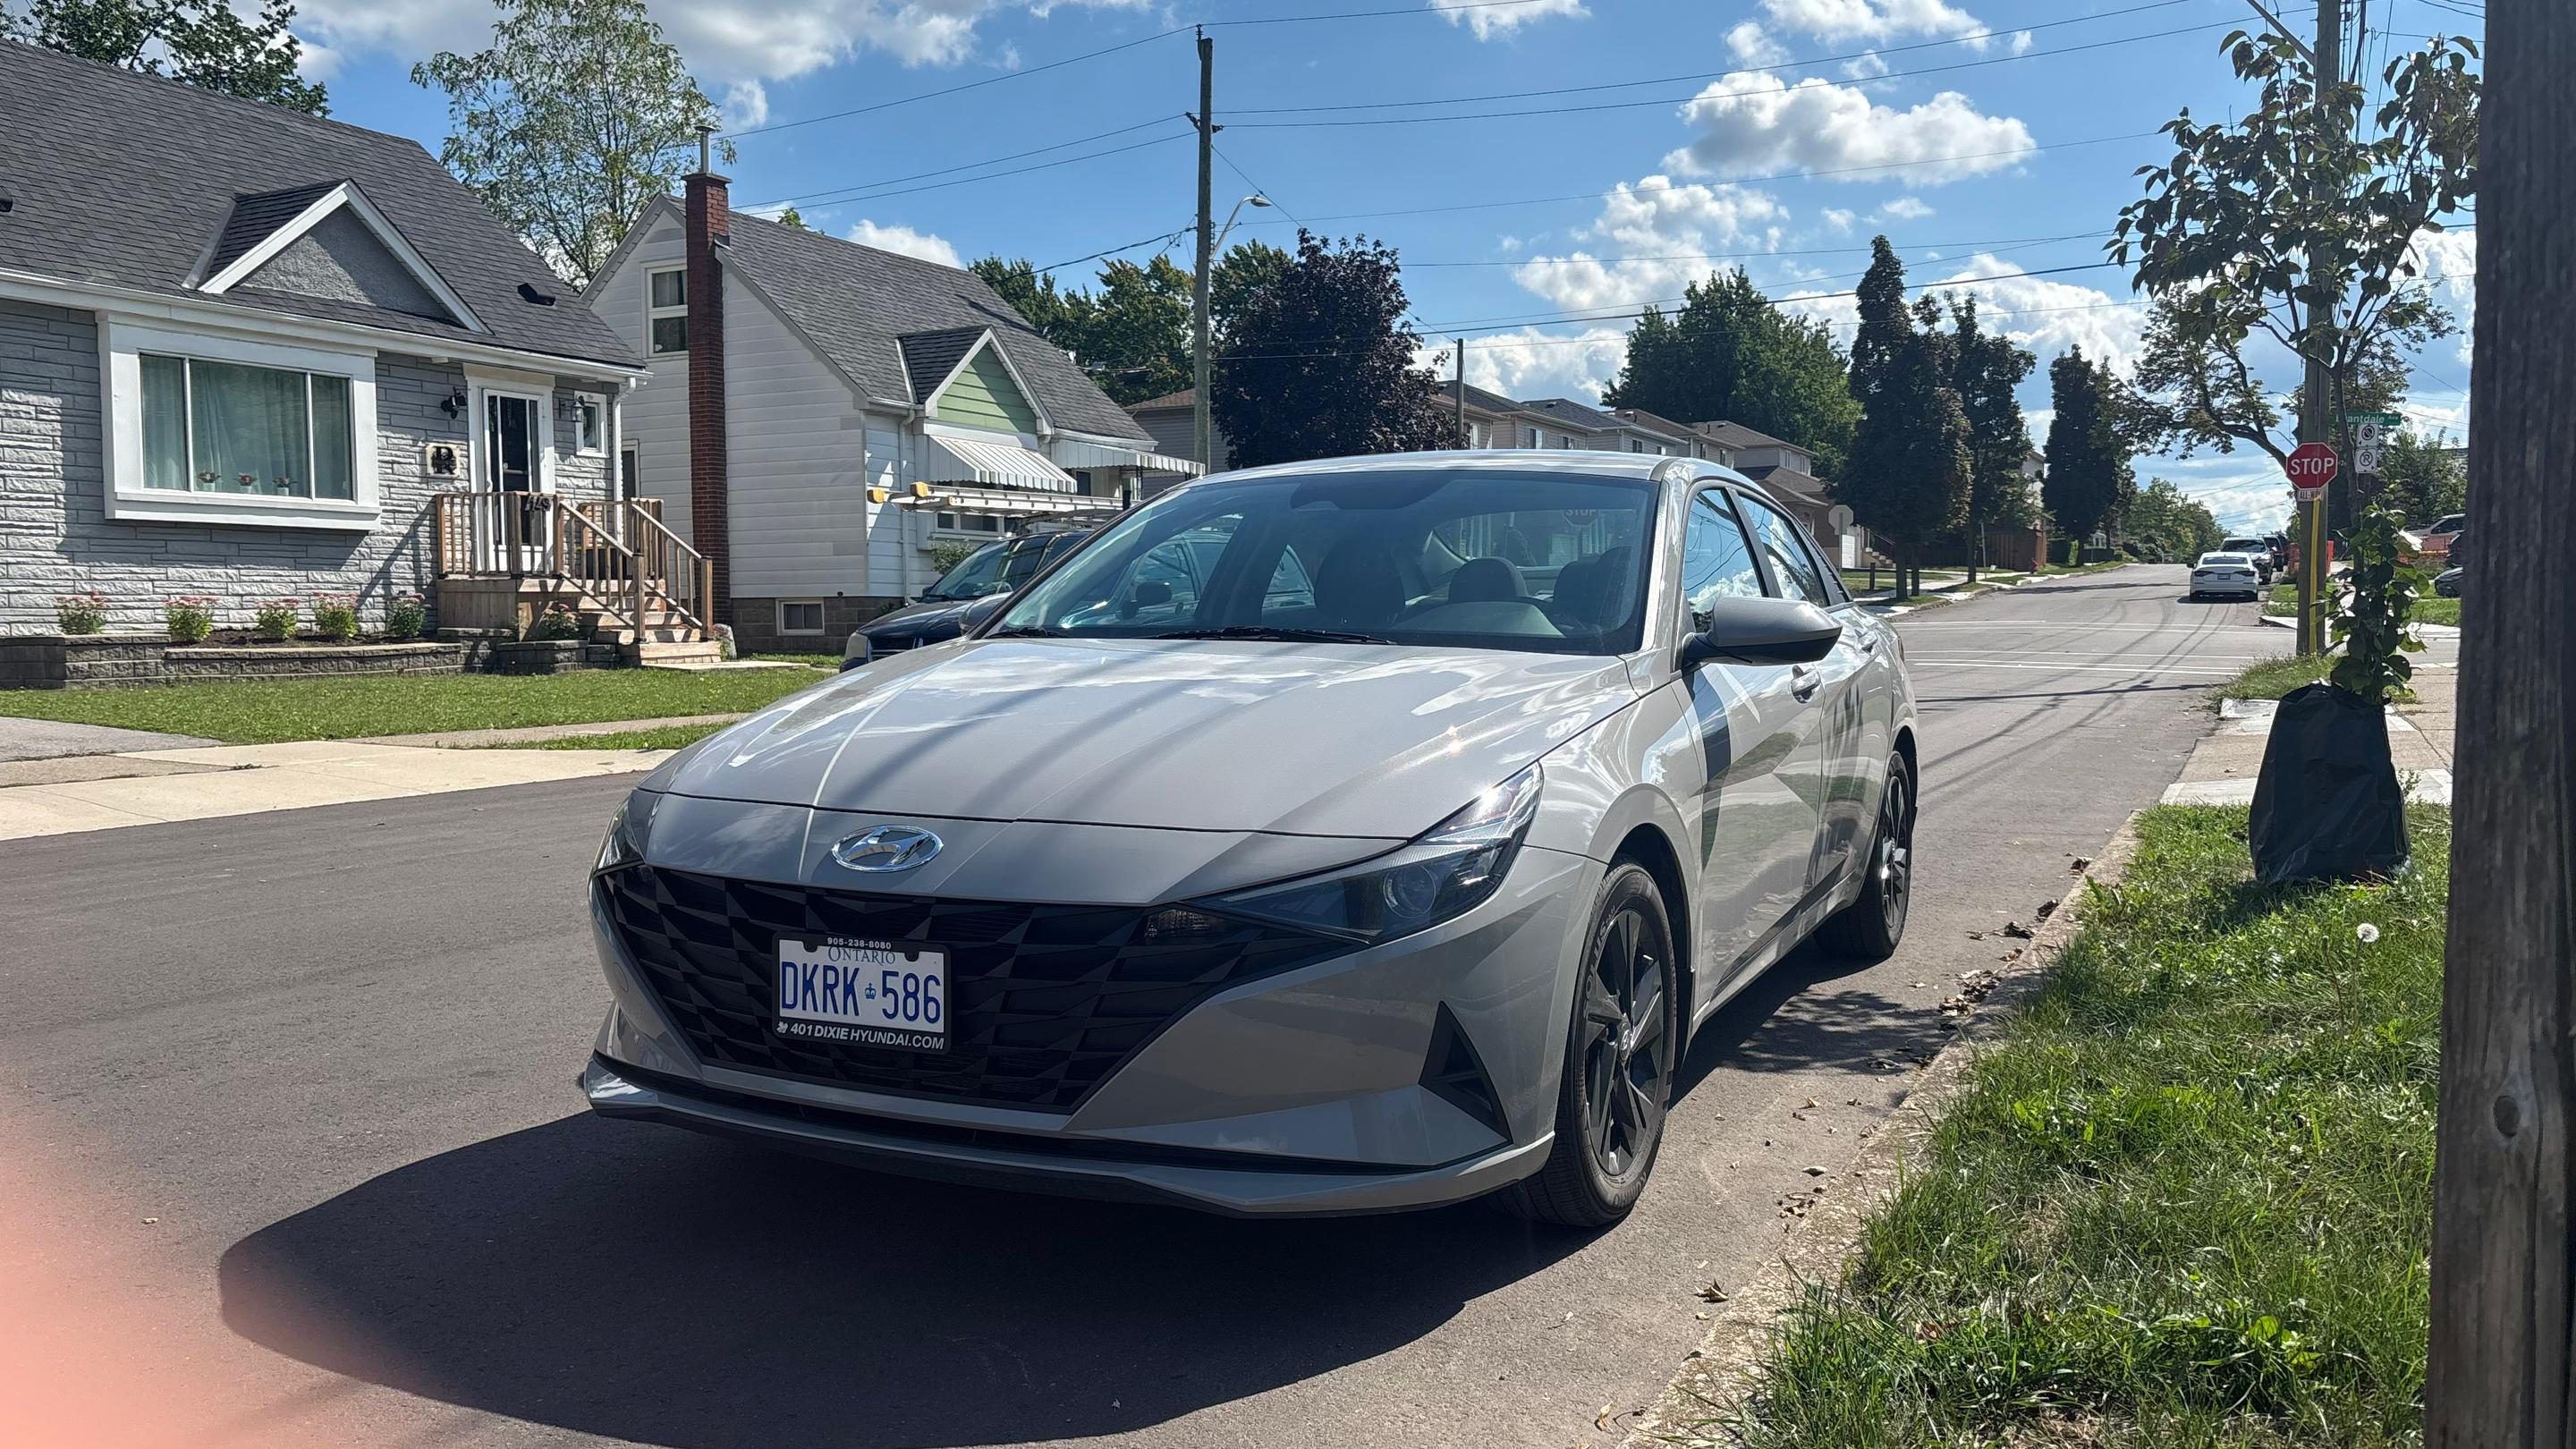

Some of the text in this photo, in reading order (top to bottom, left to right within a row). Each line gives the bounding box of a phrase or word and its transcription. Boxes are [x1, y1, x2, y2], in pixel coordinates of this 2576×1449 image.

[2335, 414, 2385, 424] antdale
[2290, 457, 2334, 476] STOP
[827, 937, 892, 950] 905-238-8080
[828, 946, 896, 966] ONTARIO
[781, 961, 941, 1024] DKRK 586
[791, 1023, 945, 1050] 401 DIXIE HYUNDAI.COM
